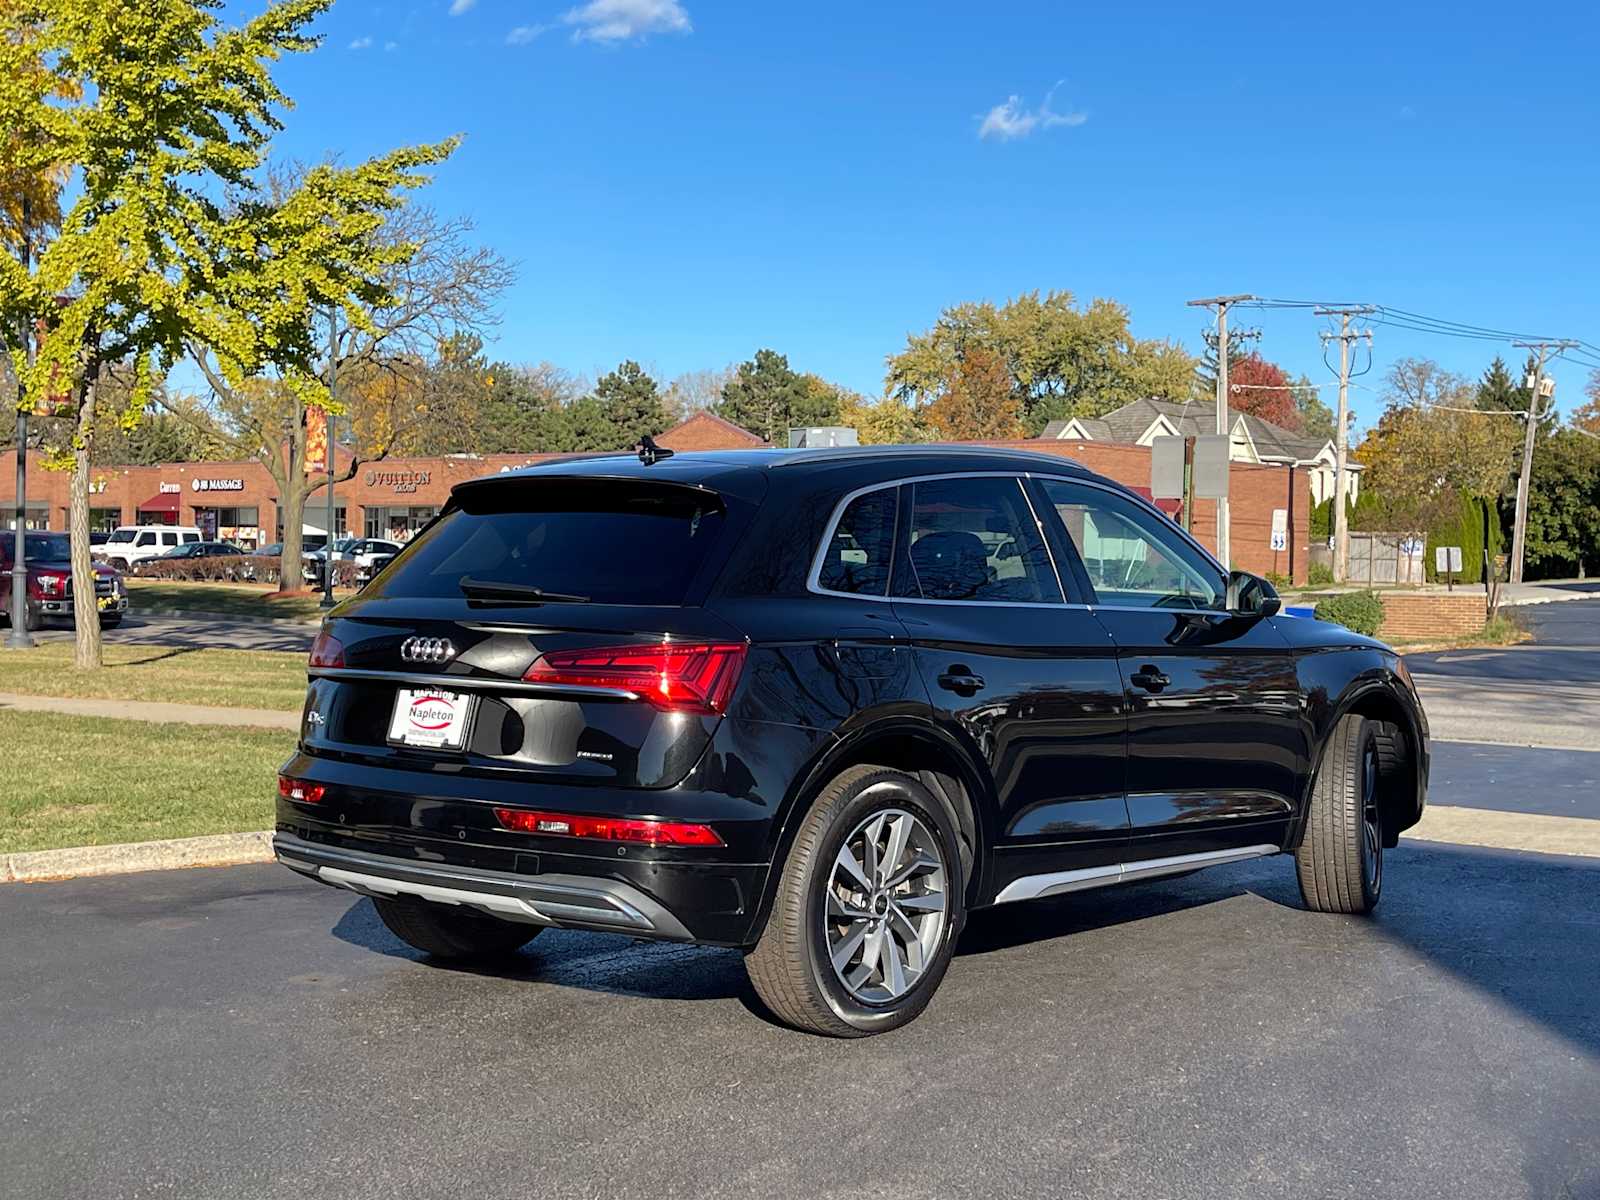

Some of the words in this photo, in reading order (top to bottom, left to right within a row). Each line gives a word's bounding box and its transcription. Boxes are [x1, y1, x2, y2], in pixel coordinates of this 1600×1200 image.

[209, 479, 243, 490] MASSAGE
[374, 471, 431, 485] VUITTON
[409, 707, 454, 721] Napleton
